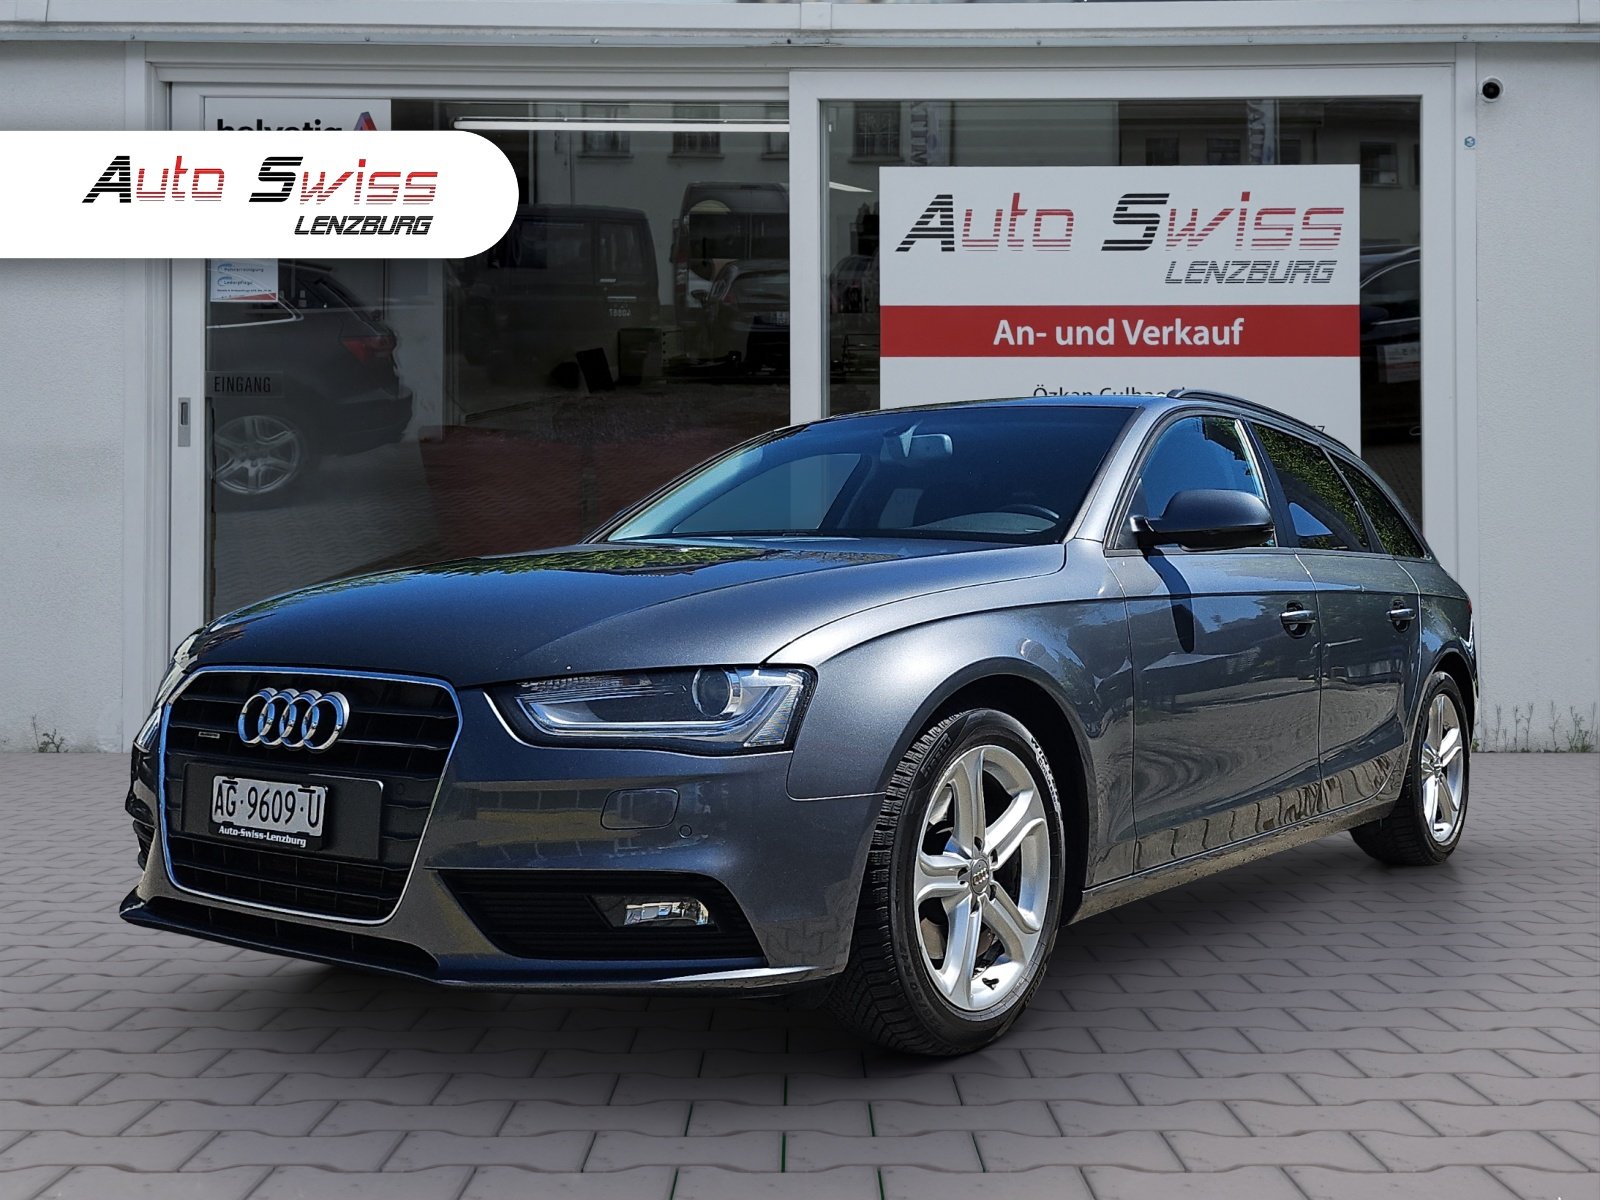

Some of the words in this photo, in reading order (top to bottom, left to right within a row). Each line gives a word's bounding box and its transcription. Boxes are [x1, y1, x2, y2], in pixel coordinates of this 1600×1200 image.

[895, 193, 1074, 252] Auto
[1101, 192, 1344, 252] Swiss
[1165, 260, 1337, 284] LENZBURG
[993, 319, 1047, 346] An-
[1056, 318, 1115, 346] und
[1122, 318, 1244, 346] Verkauf
[214, 376, 271, 393] EINGANG
